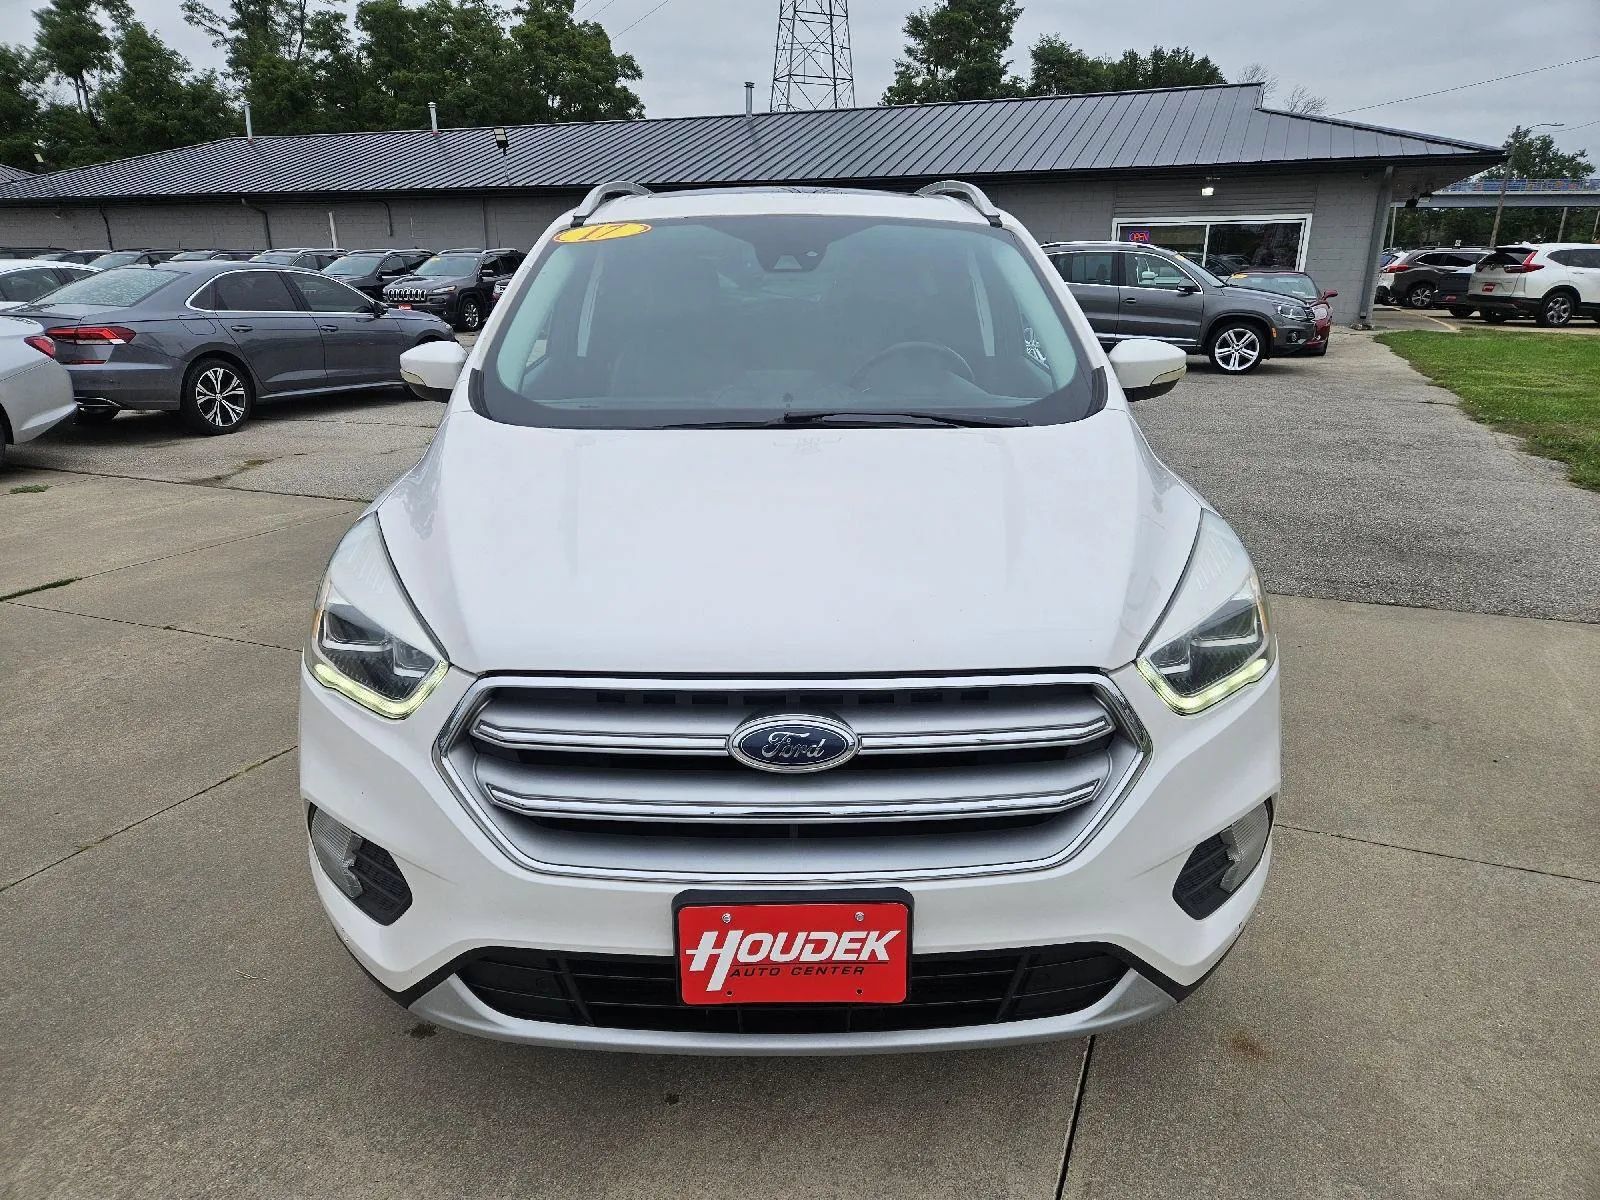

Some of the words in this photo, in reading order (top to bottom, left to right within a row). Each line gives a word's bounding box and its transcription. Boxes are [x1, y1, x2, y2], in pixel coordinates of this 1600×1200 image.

[578, 223, 629, 241] 17
[1129, 231, 1150, 242] OPEN
[761, 731, 827, 758] Ford
[686, 930, 902, 992] HOUDEK
[729, 966, 782, 978] AUTO
[790, 965, 865, 977] CENTER
